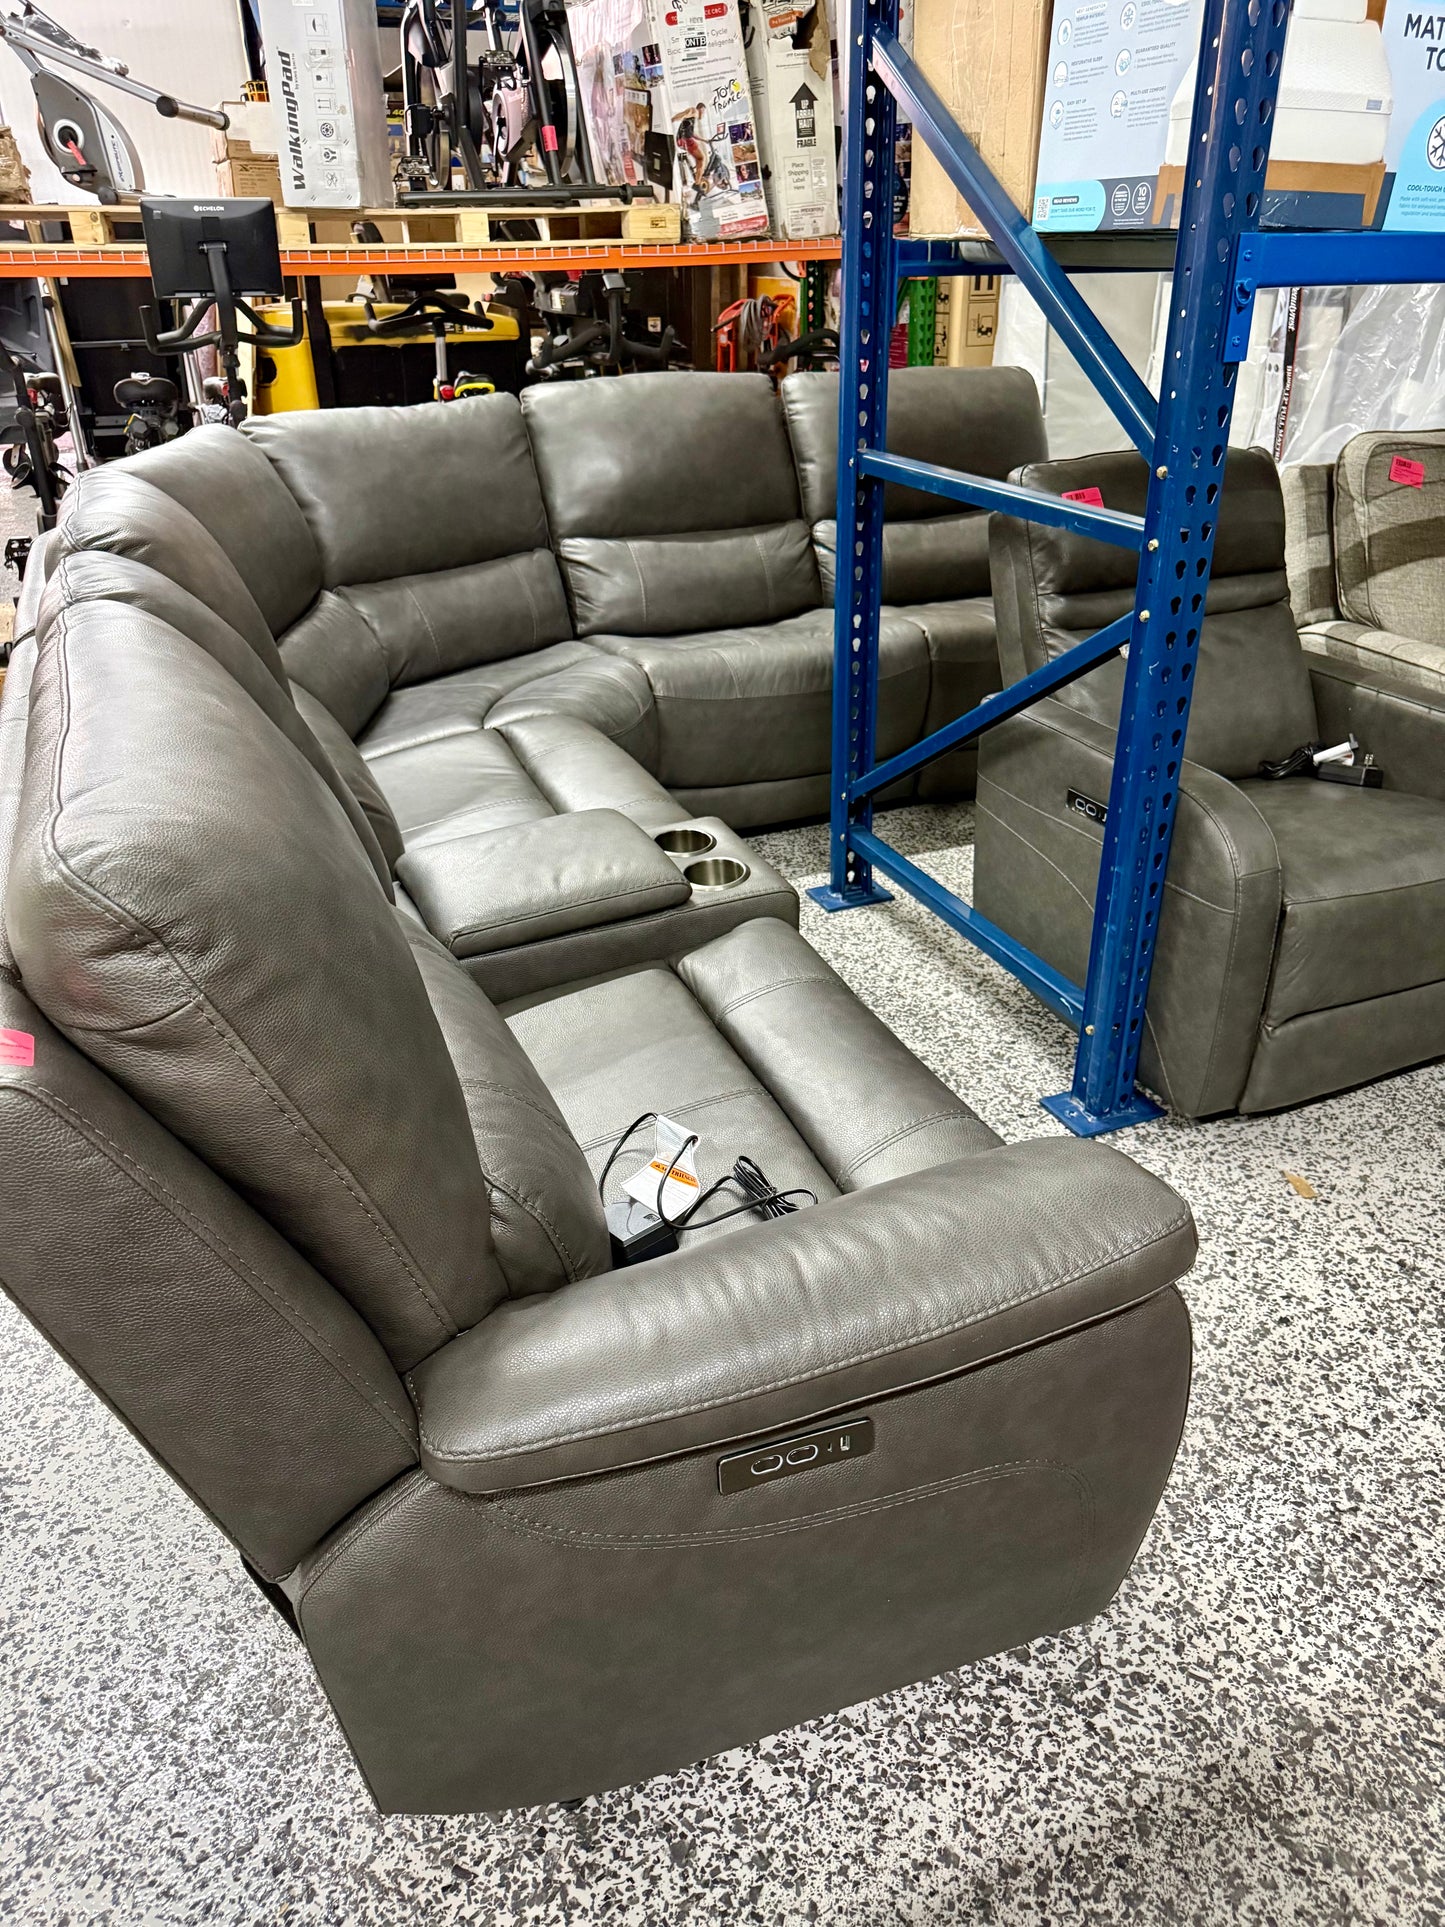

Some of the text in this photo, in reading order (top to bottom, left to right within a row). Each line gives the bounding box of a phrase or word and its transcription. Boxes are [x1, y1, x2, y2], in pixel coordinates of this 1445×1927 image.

[278, 50, 305, 190] WalkingPad
[1138, 187, 1146, 196] 10
[1407, 184, 1443, 192] COOL-TOUCH
